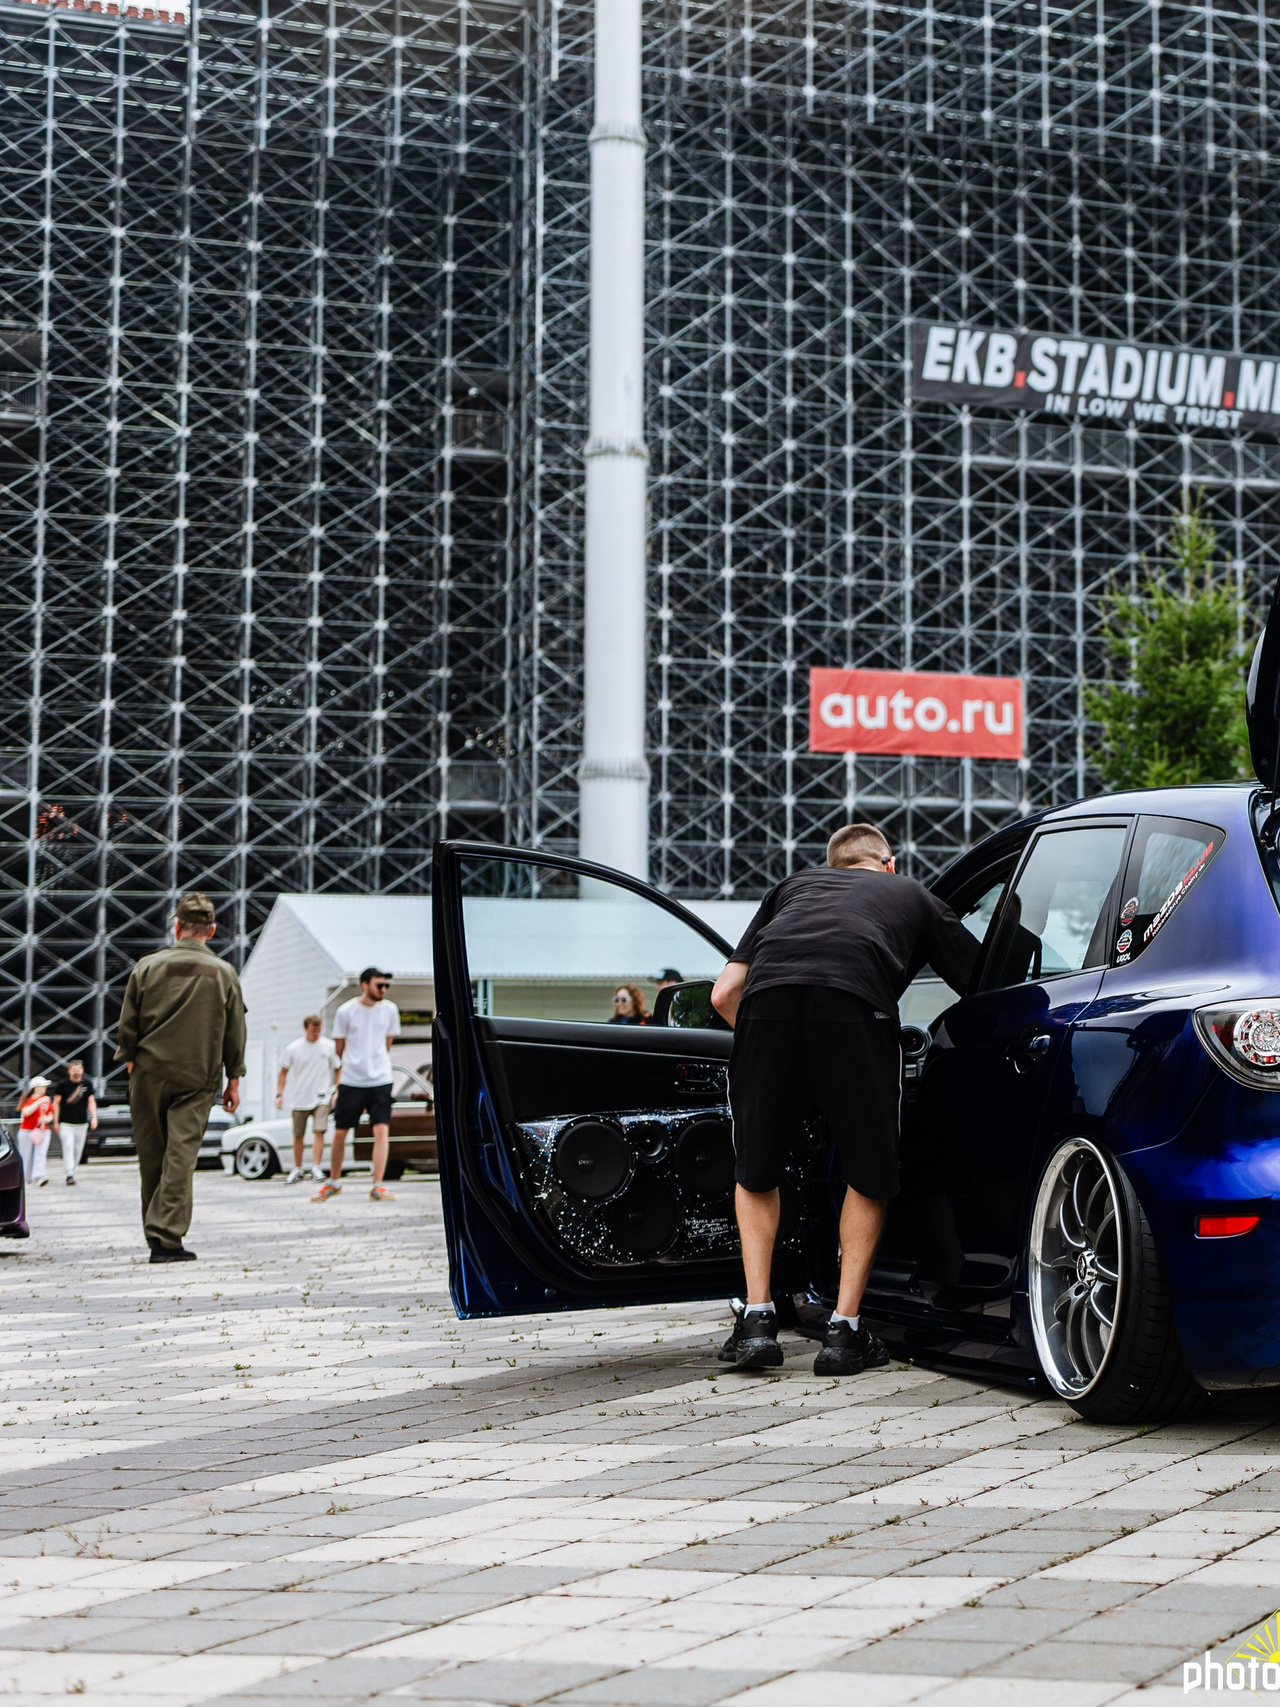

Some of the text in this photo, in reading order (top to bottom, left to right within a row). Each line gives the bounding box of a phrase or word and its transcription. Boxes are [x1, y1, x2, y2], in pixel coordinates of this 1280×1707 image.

[1044, 393, 1244, 429] IN LOW WE TRUST
[820, 689, 1014, 735] auto.ru
